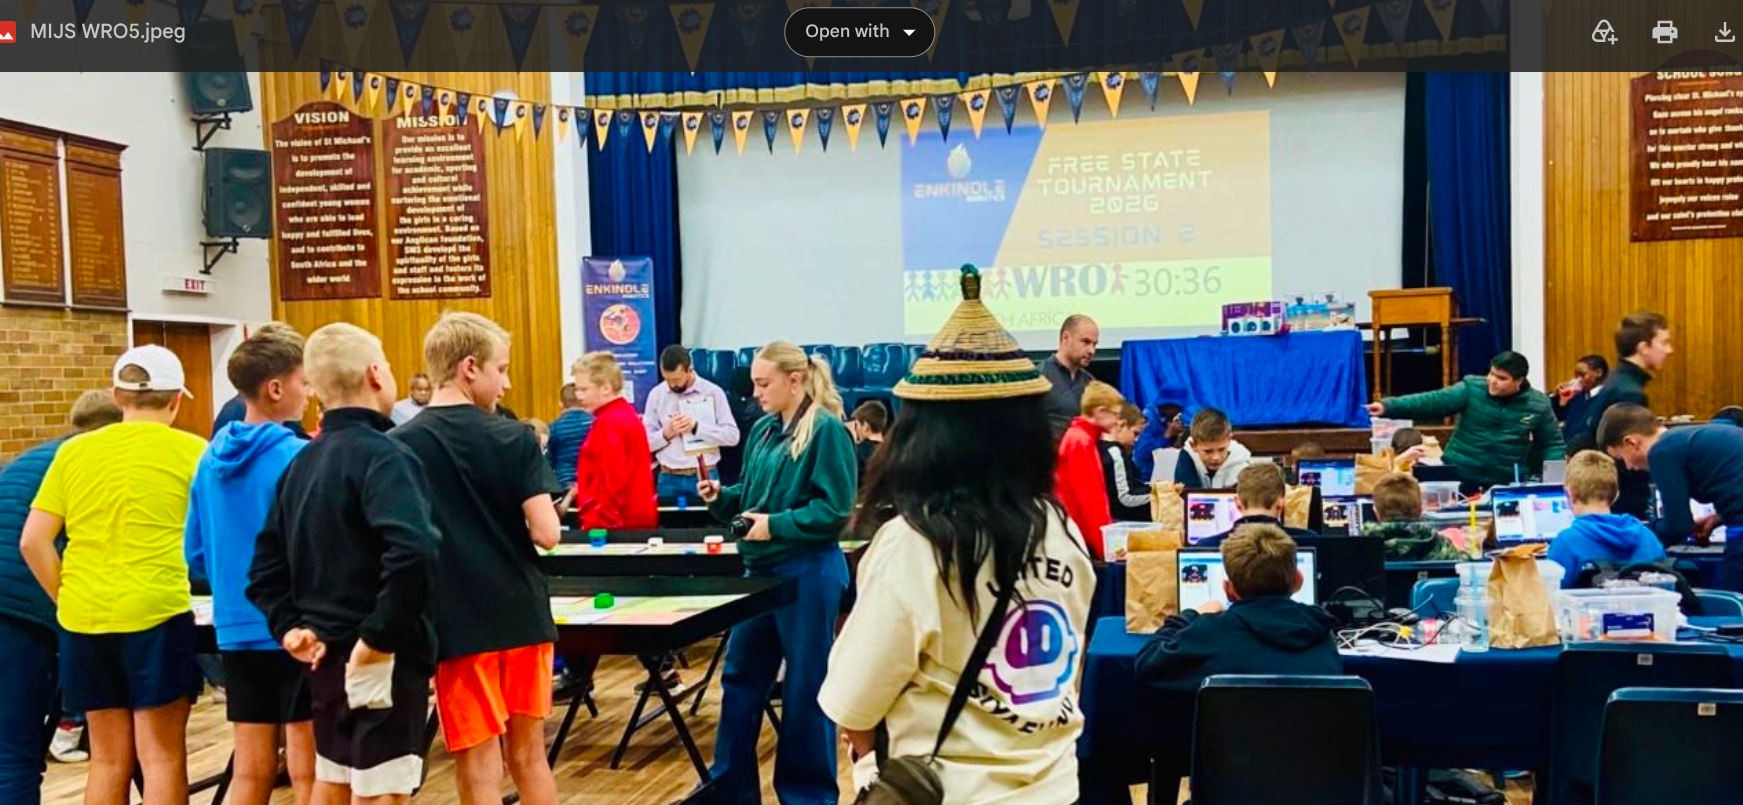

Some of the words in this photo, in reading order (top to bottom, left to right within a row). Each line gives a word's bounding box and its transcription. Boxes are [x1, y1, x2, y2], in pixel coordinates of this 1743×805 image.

[294, 111, 351, 124] VISION
[396, 114, 468, 129] MISSO
[1048, 155, 1110, 175] FREE
[1121, 149, 1201, 170] STATE
[913, 180, 1006, 198] ENKINDLE
[1037, 170, 1212, 196] TOURNAMENT
[1089, 194, 1159, 214] 2026
[1037, 224, 1162, 249] SESSION
[1177, 224, 1196, 246] 2
[184, 278, 205, 291] EXIT
[585, 283, 650, 295] ENKINDLE
[1012, 263, 1107, 299] WRO
[1133, 265, 1222, 297] 30:36
[1017, 310, 1070, 326] AFRIC
